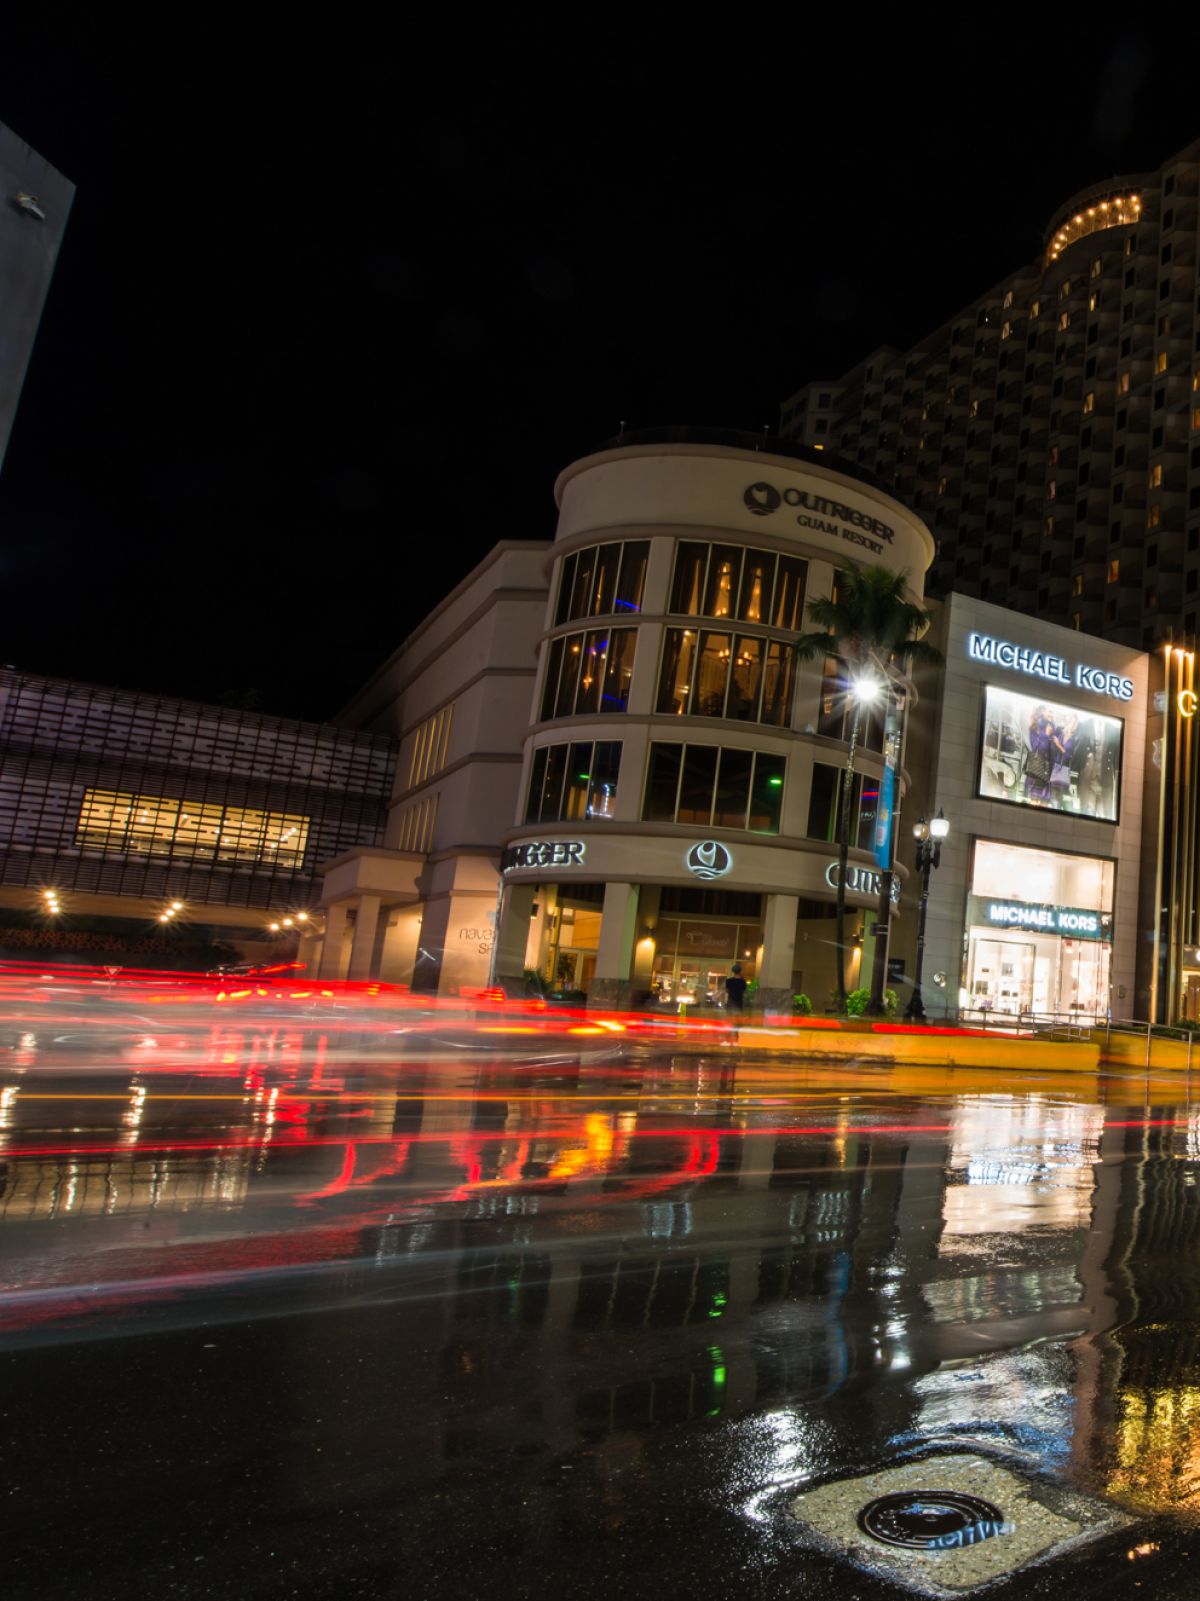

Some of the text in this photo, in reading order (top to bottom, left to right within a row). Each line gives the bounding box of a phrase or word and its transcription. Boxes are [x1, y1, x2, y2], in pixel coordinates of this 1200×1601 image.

[783, 487, 895, 545] OUTRIGGER
[797, 514, 884, 555] GUAM RESORT
[970, 634, 1134, 700] MICHAEL KORS
[990, 905, 1098, 932] MICHAEL KORS
